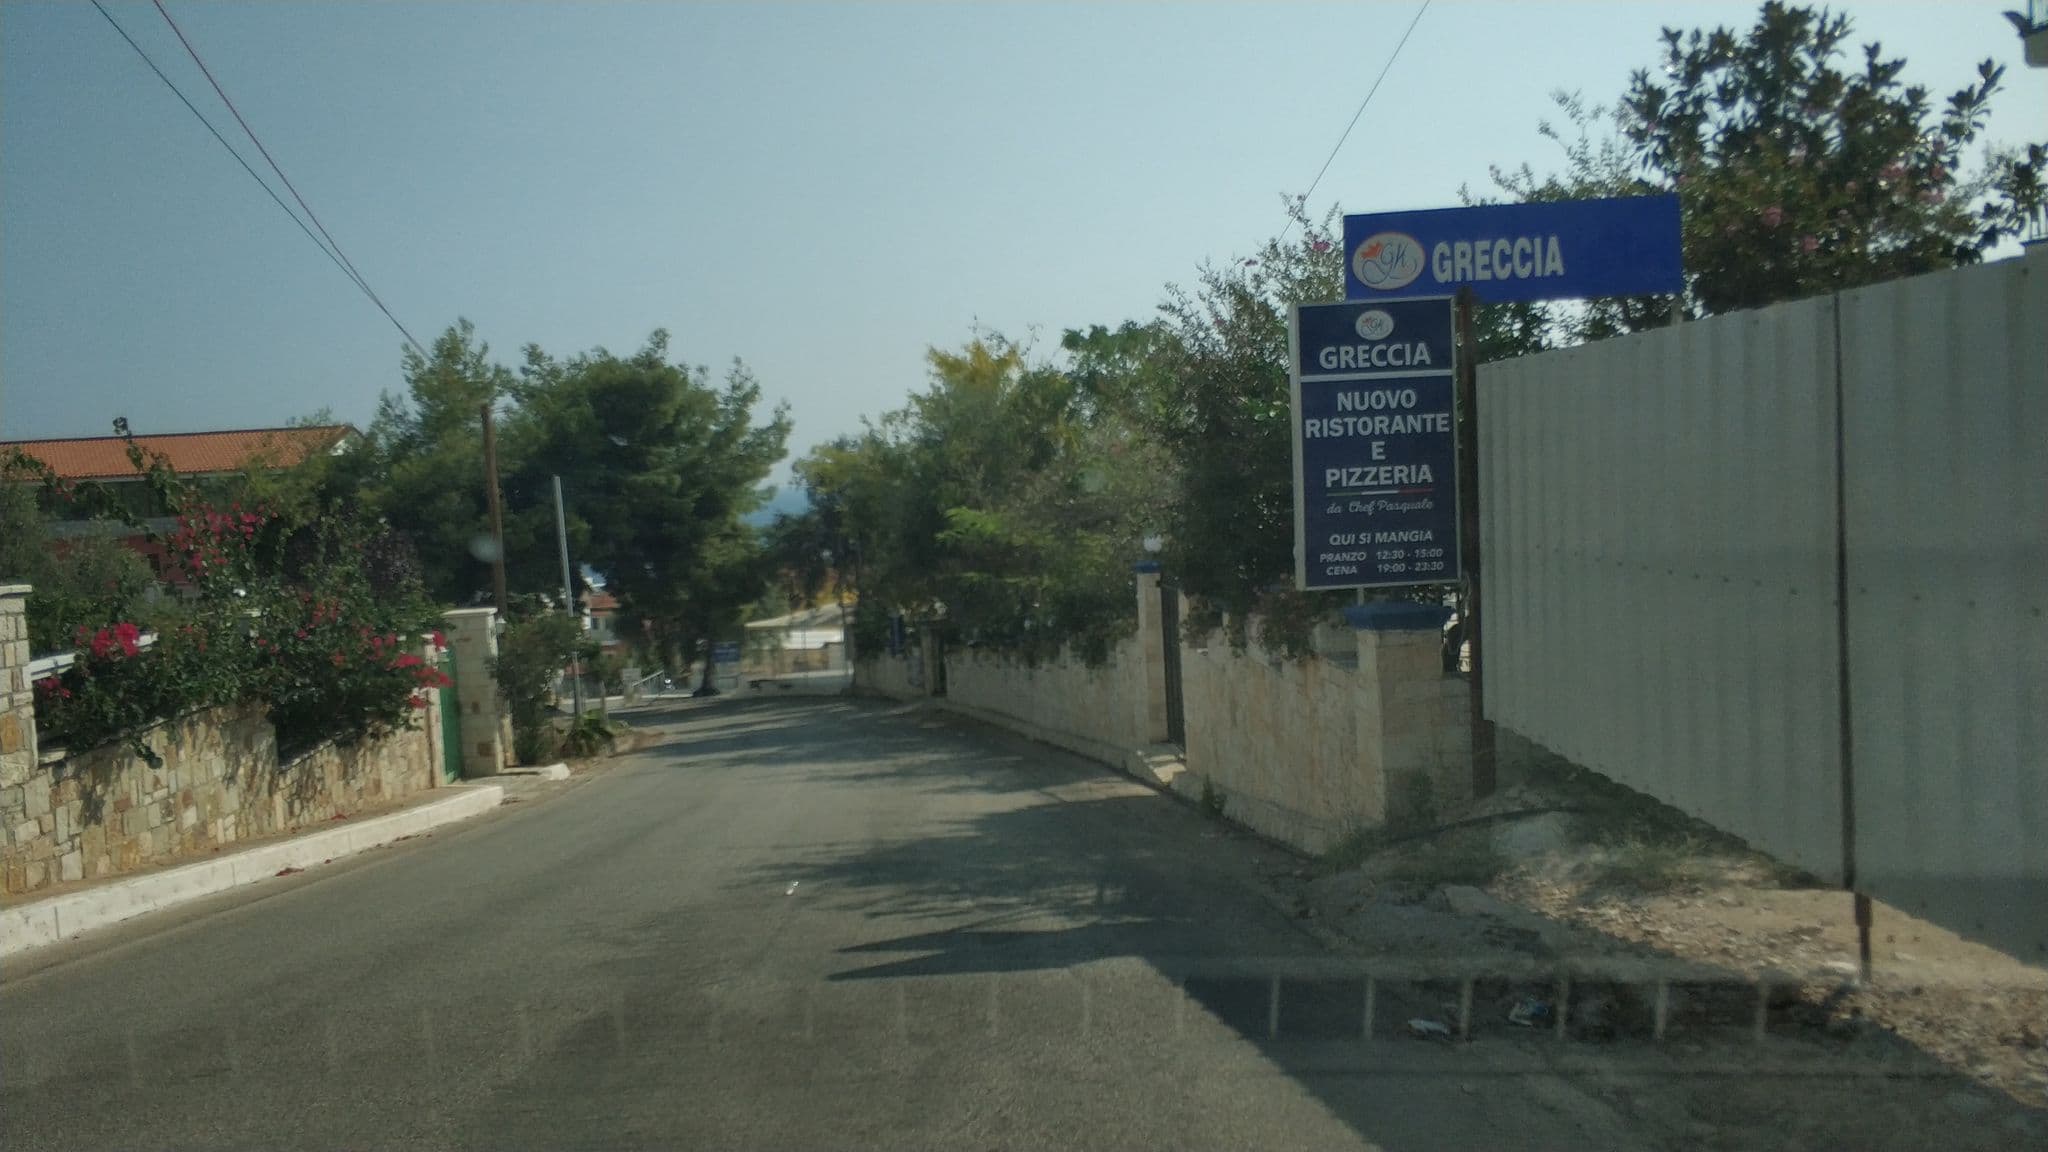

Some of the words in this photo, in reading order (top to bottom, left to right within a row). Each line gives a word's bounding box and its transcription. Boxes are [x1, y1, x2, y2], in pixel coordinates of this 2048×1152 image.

[1432, 235, 1564, 283] GRECCIA
[1319, 343, 1431, 370] GRECCIA
[1337, 389, 1416, 412] NUOVO
[1305, 413, 1449, 439] RISTORANTE
[1371, 442, 1386, 461] E
[1326, 464, 1433, 488] PIZZERIA
[1326, 501, 1342, 515] da
[1349, 499, 1375, 517] Chef
[1377, 497, 1433, 516] Pasquale
[1329, 533, 1355, 546] QUI
[1359, 533, 1371, 545] SI
[1375, 530, 1433, 544] MANGIA
[1320, 551, 1367, 563] PRANZO
[1375, 550, 1404, 560] 12:30
[1414, 548, 1443, 558] 15:00
[1326, 565, 1357, 576] CENA
[1377, 563, 1405, 573] 19:00
[1415, 561, 1443, 572] 23:30
